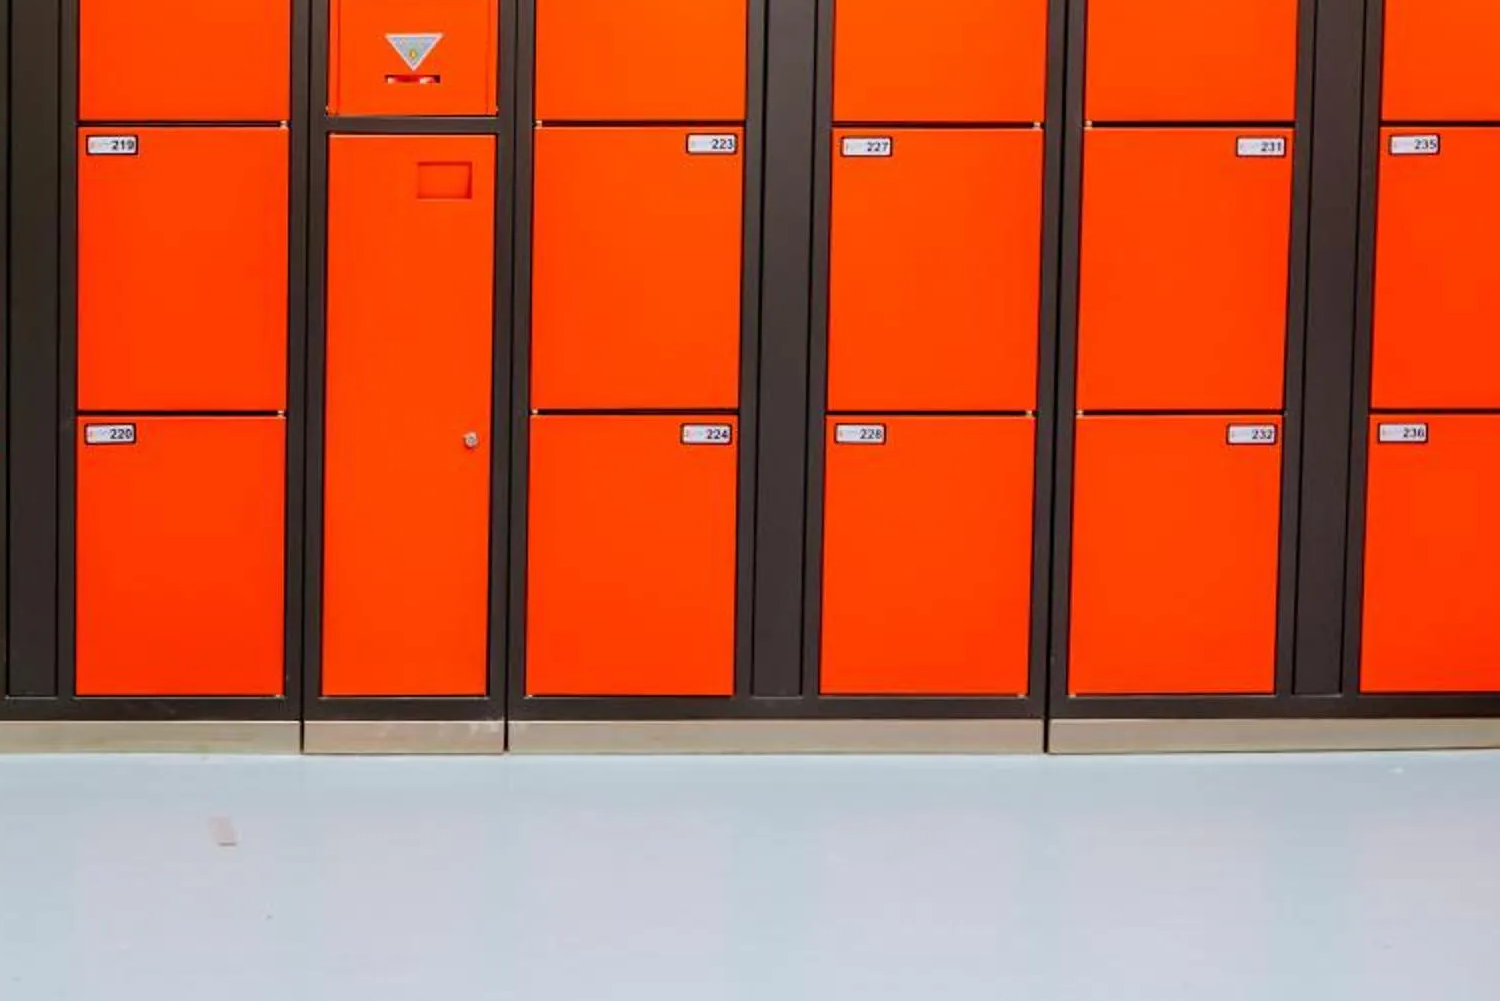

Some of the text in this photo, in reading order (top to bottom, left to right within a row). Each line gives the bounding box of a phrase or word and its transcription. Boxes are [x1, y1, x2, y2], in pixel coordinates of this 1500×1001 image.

[111, 140, 134, 151] 219
[711, 139, 734, 149] 223
[867, 142, 888, 152] 227
[1260, 142, 1281, 152] 231
[1414, 139, 1436, 149] 235
[110, 428, 132, 439] 220
[706, 429, 729, 439] 224
[860, 428, 882, 439] 228
[1252, 429, 1272, 440] 232
[1403, 428, 1424, 438] 236
